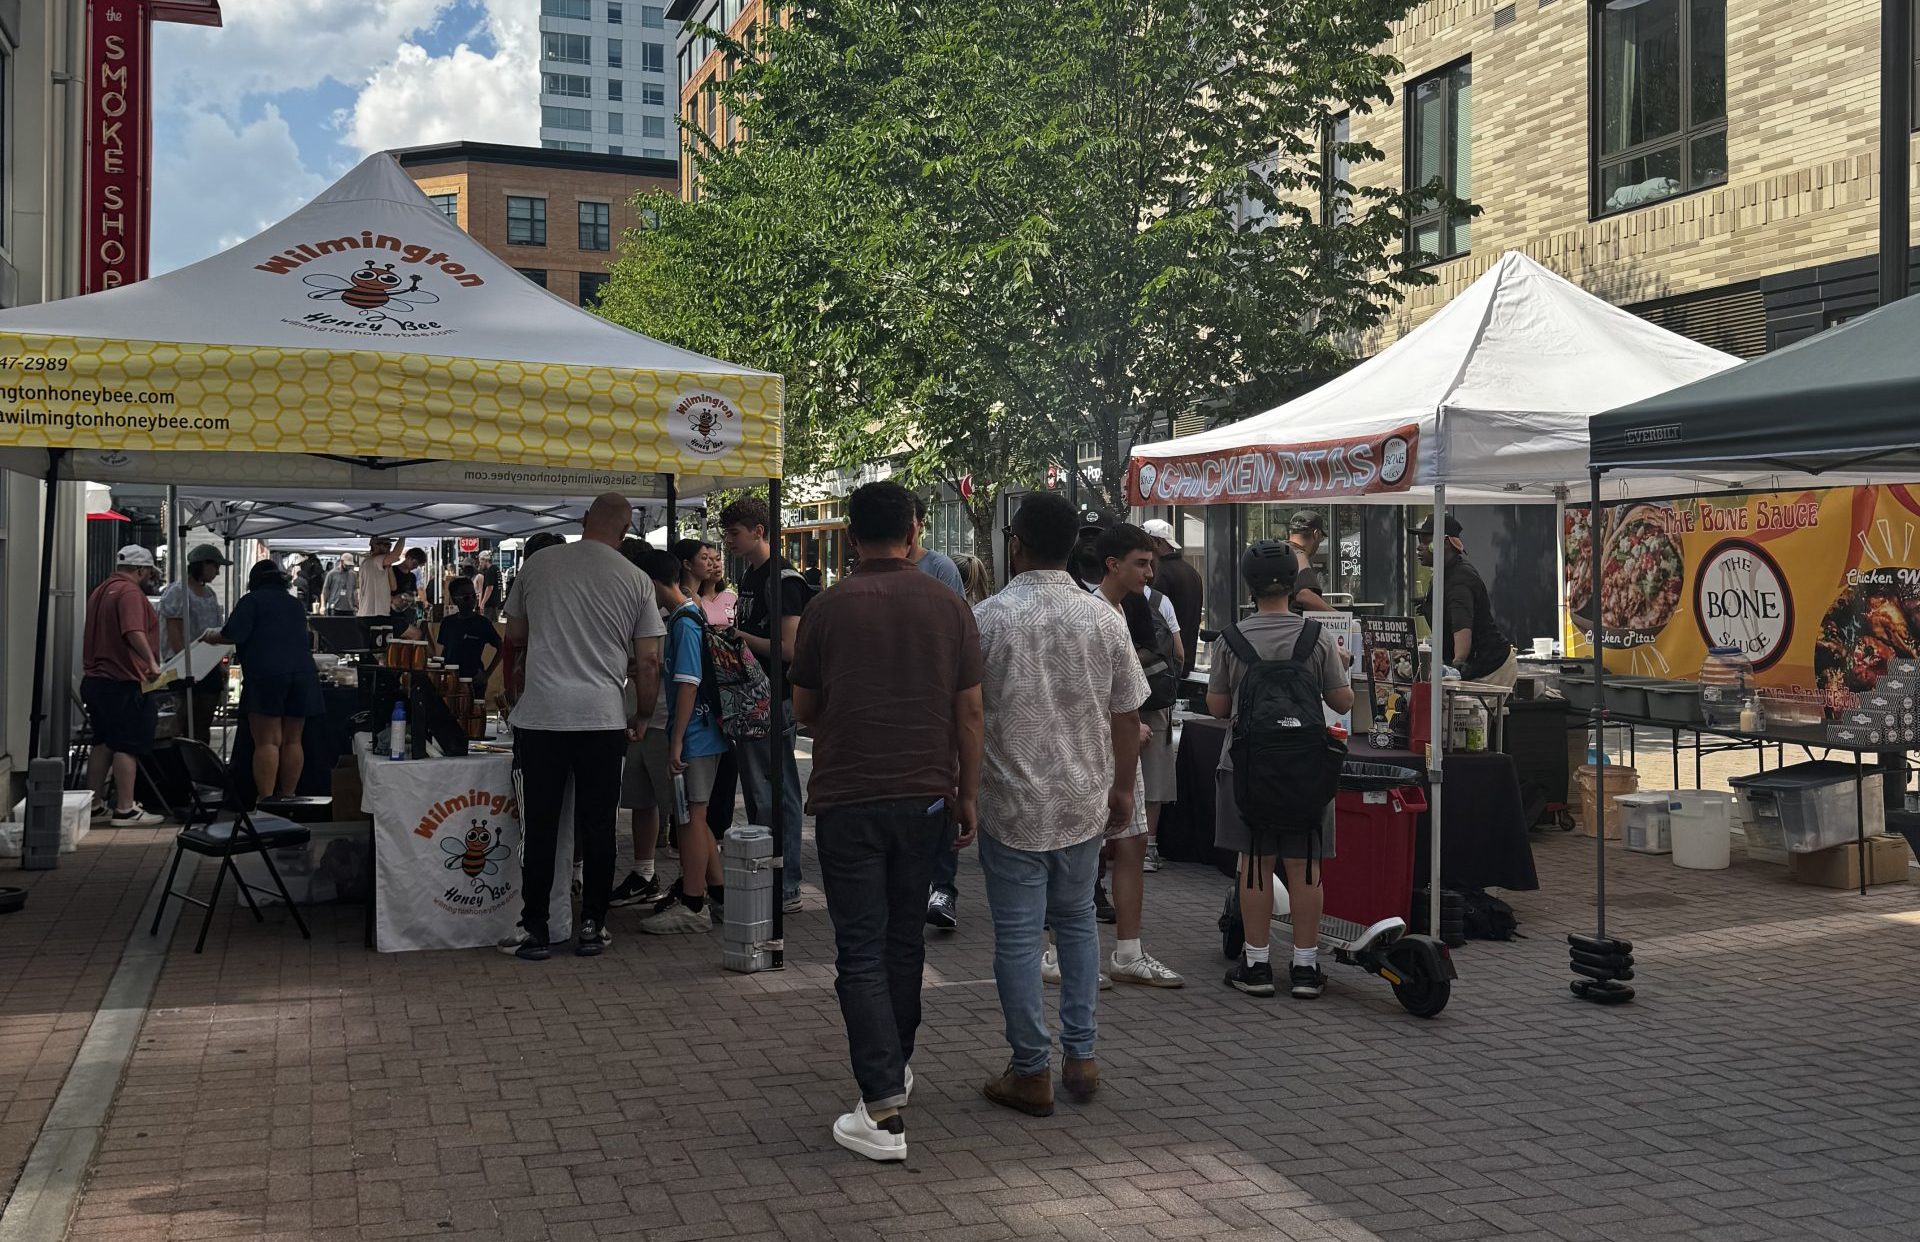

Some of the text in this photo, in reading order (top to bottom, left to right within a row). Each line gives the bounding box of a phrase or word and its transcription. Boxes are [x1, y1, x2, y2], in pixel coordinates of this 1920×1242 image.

[100, 6, 127, 290] the SMOKE SHOP
[253, 230, 485, 288] Wilmington
[303, 312, 442, 332] Honey Bee
[676, 393, 734, 419] Wilmington
[1627, 426, 1680, 443] EVERBILT
[1157, 443, 1377, 499] CHICKEN PITAS
[1660, 501, 1819, 536] THE BONE SAUCE
[461, 538, 478, 547] STOP
[1721, 556, 1753, 574] THE
[1846, 568, 1894, 586] Chicken
[1706, 588, 1780, 620] BONE
[1367, 620, 1408, 632] THE BONE
[1375, 632, 1401, 643] SAUCE
[1623, 630, 1656, 647] Pitas
[1718, 631, 1772, 655] SAUCE
[413, 788, 519, 839] Wilmingto
[443, 881, 511, 907] Honey Bee
